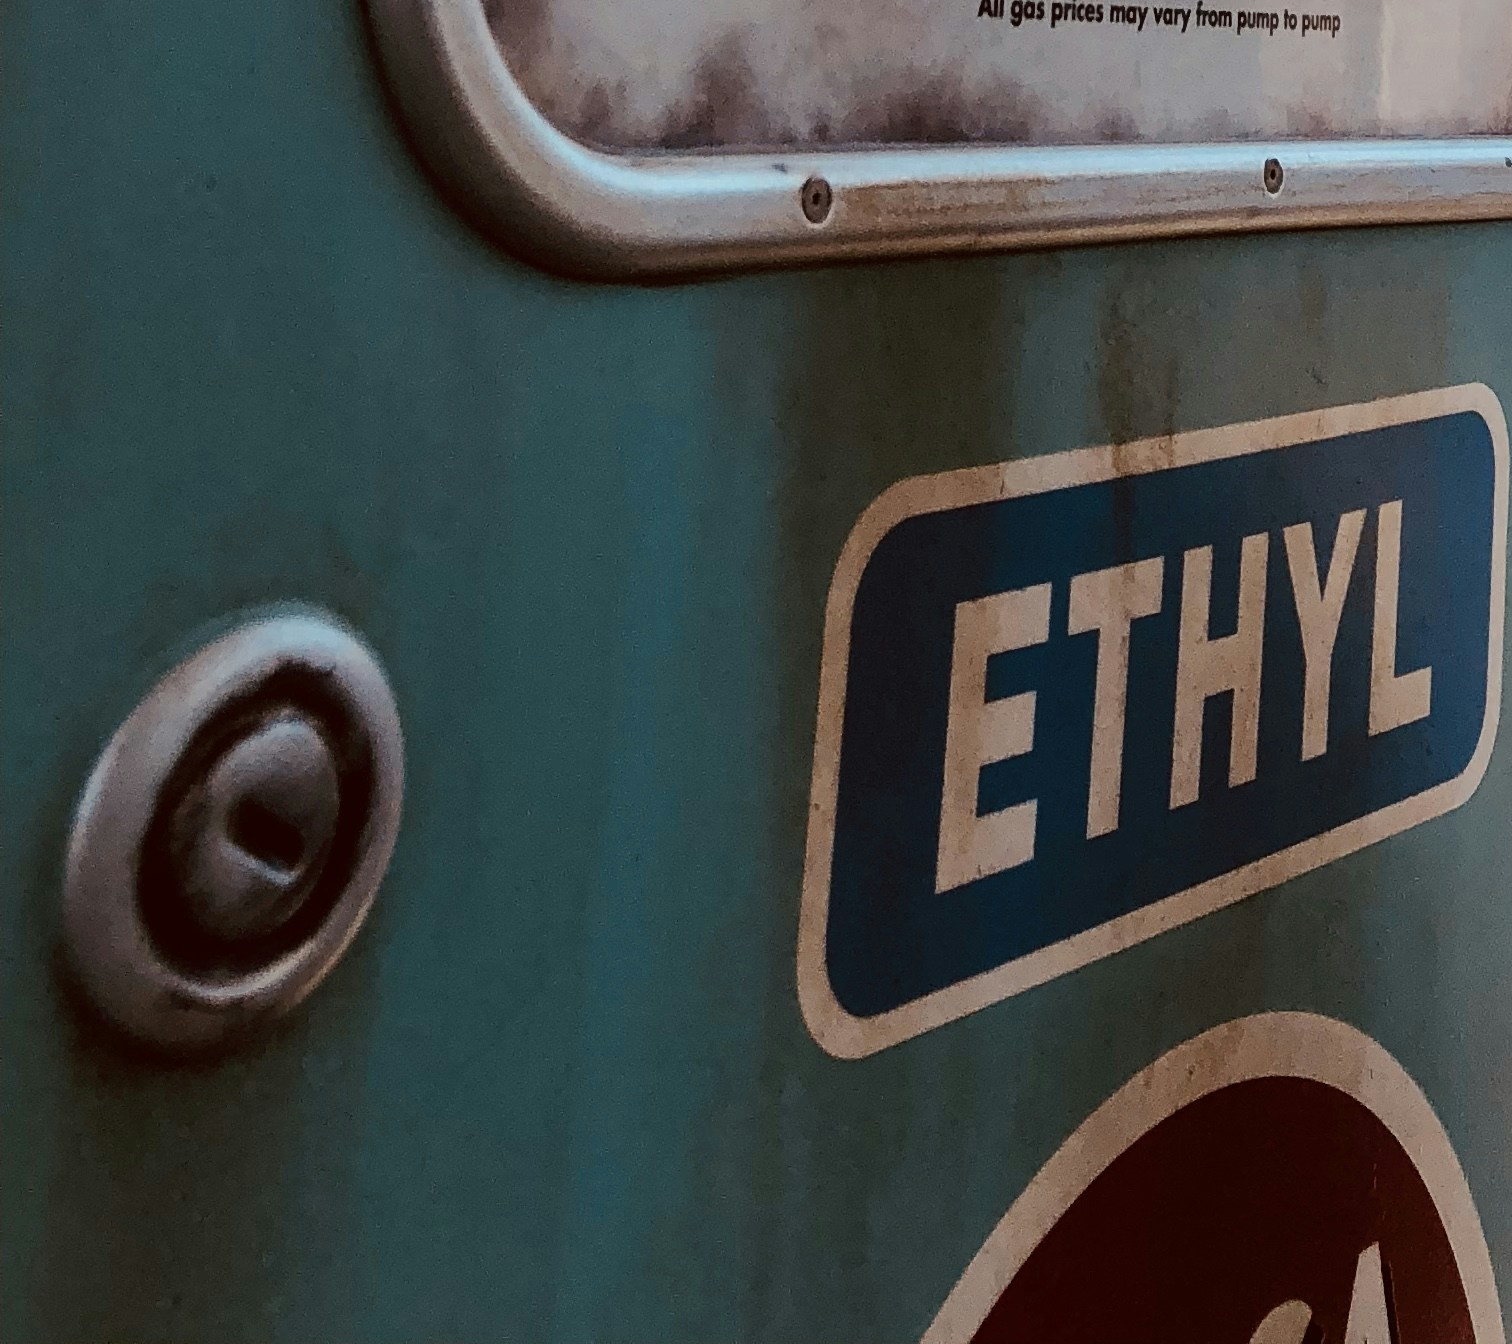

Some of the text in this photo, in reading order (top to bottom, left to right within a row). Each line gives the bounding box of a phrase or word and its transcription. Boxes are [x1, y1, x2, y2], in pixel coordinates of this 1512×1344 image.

[1010, 0, 1046, 27] gas
[1109, 2, 1149, 32] may
[1153, 5, 1192, 33] vary
[1196, 0, 1233, 29] from
[1236, 11, 1280, 36] pump
[1283, 9, 1298, 31] to
[1301, 11, 1342, 38] pump
[934, 499, 1433, 895] ETHYL
